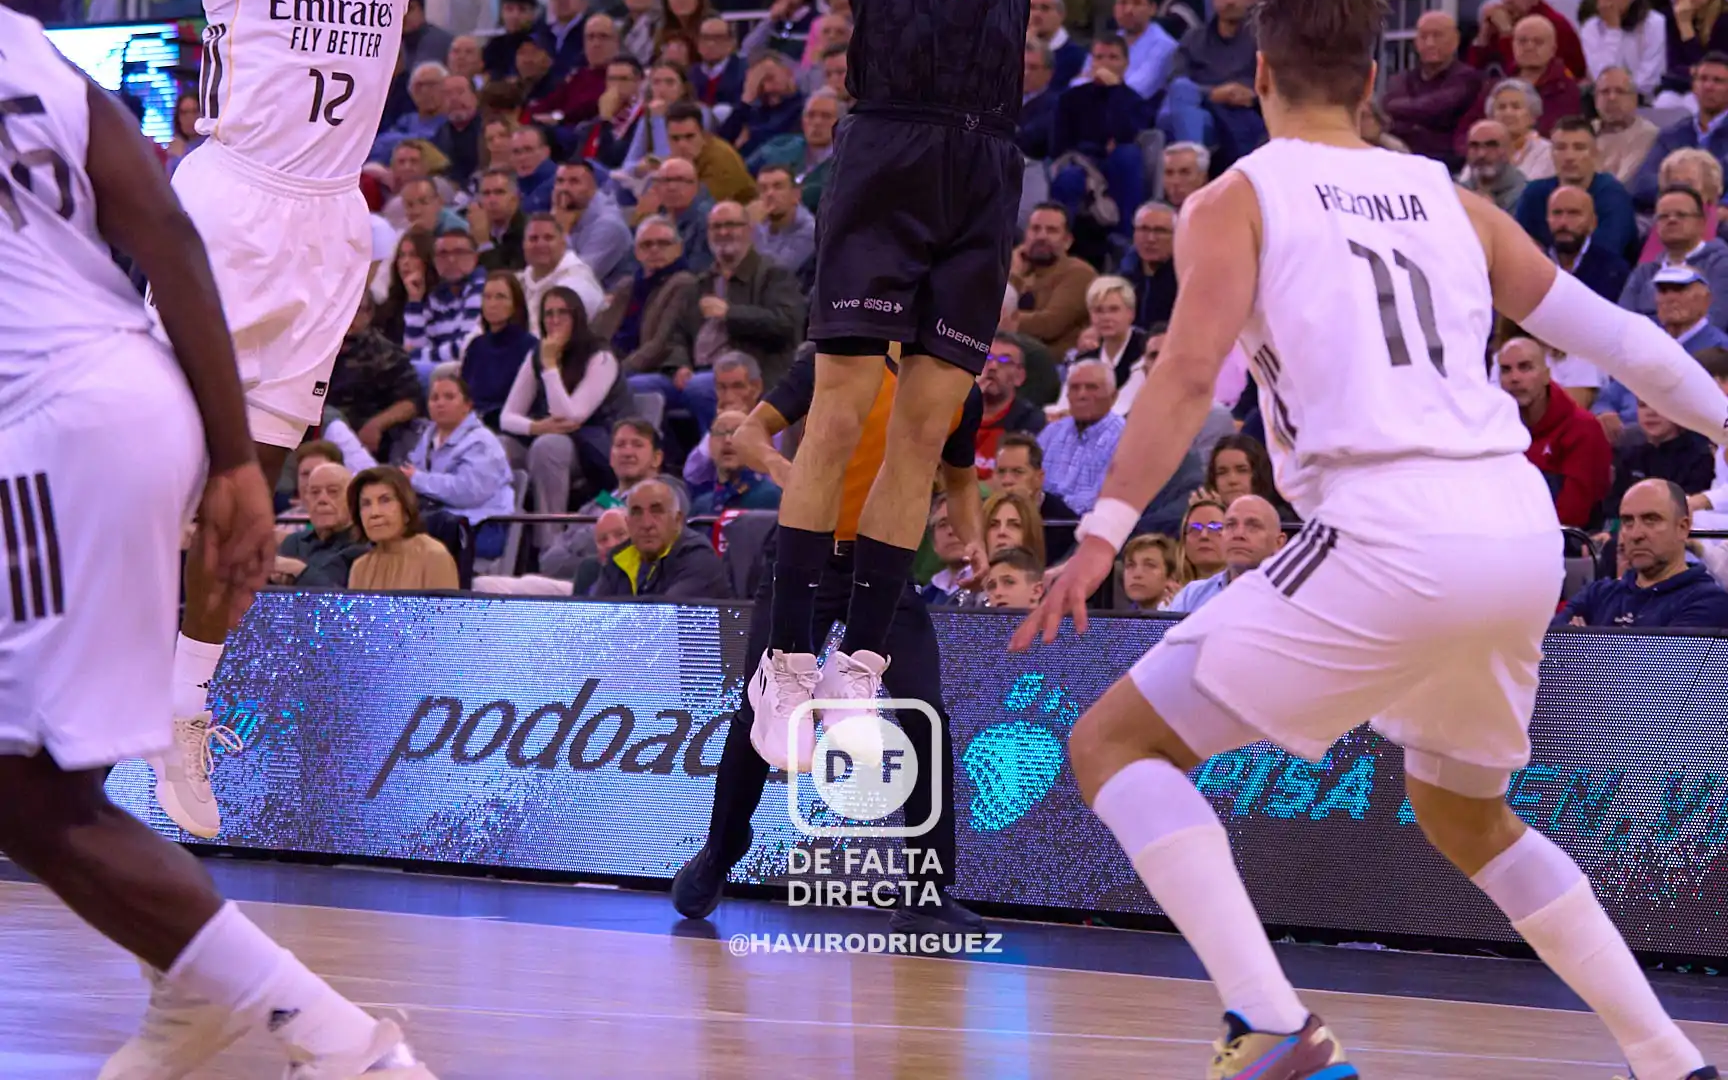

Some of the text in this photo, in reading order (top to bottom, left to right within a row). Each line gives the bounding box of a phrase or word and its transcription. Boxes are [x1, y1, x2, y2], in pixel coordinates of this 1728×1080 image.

[290, 26, 382, 58] FLY BETTER
[309, 68, 355, 126] 12
[832, 298, 860, 310] vive
[1346, 238, 1448, 379] 11
[1196, 745, 1375, 820] PISA
